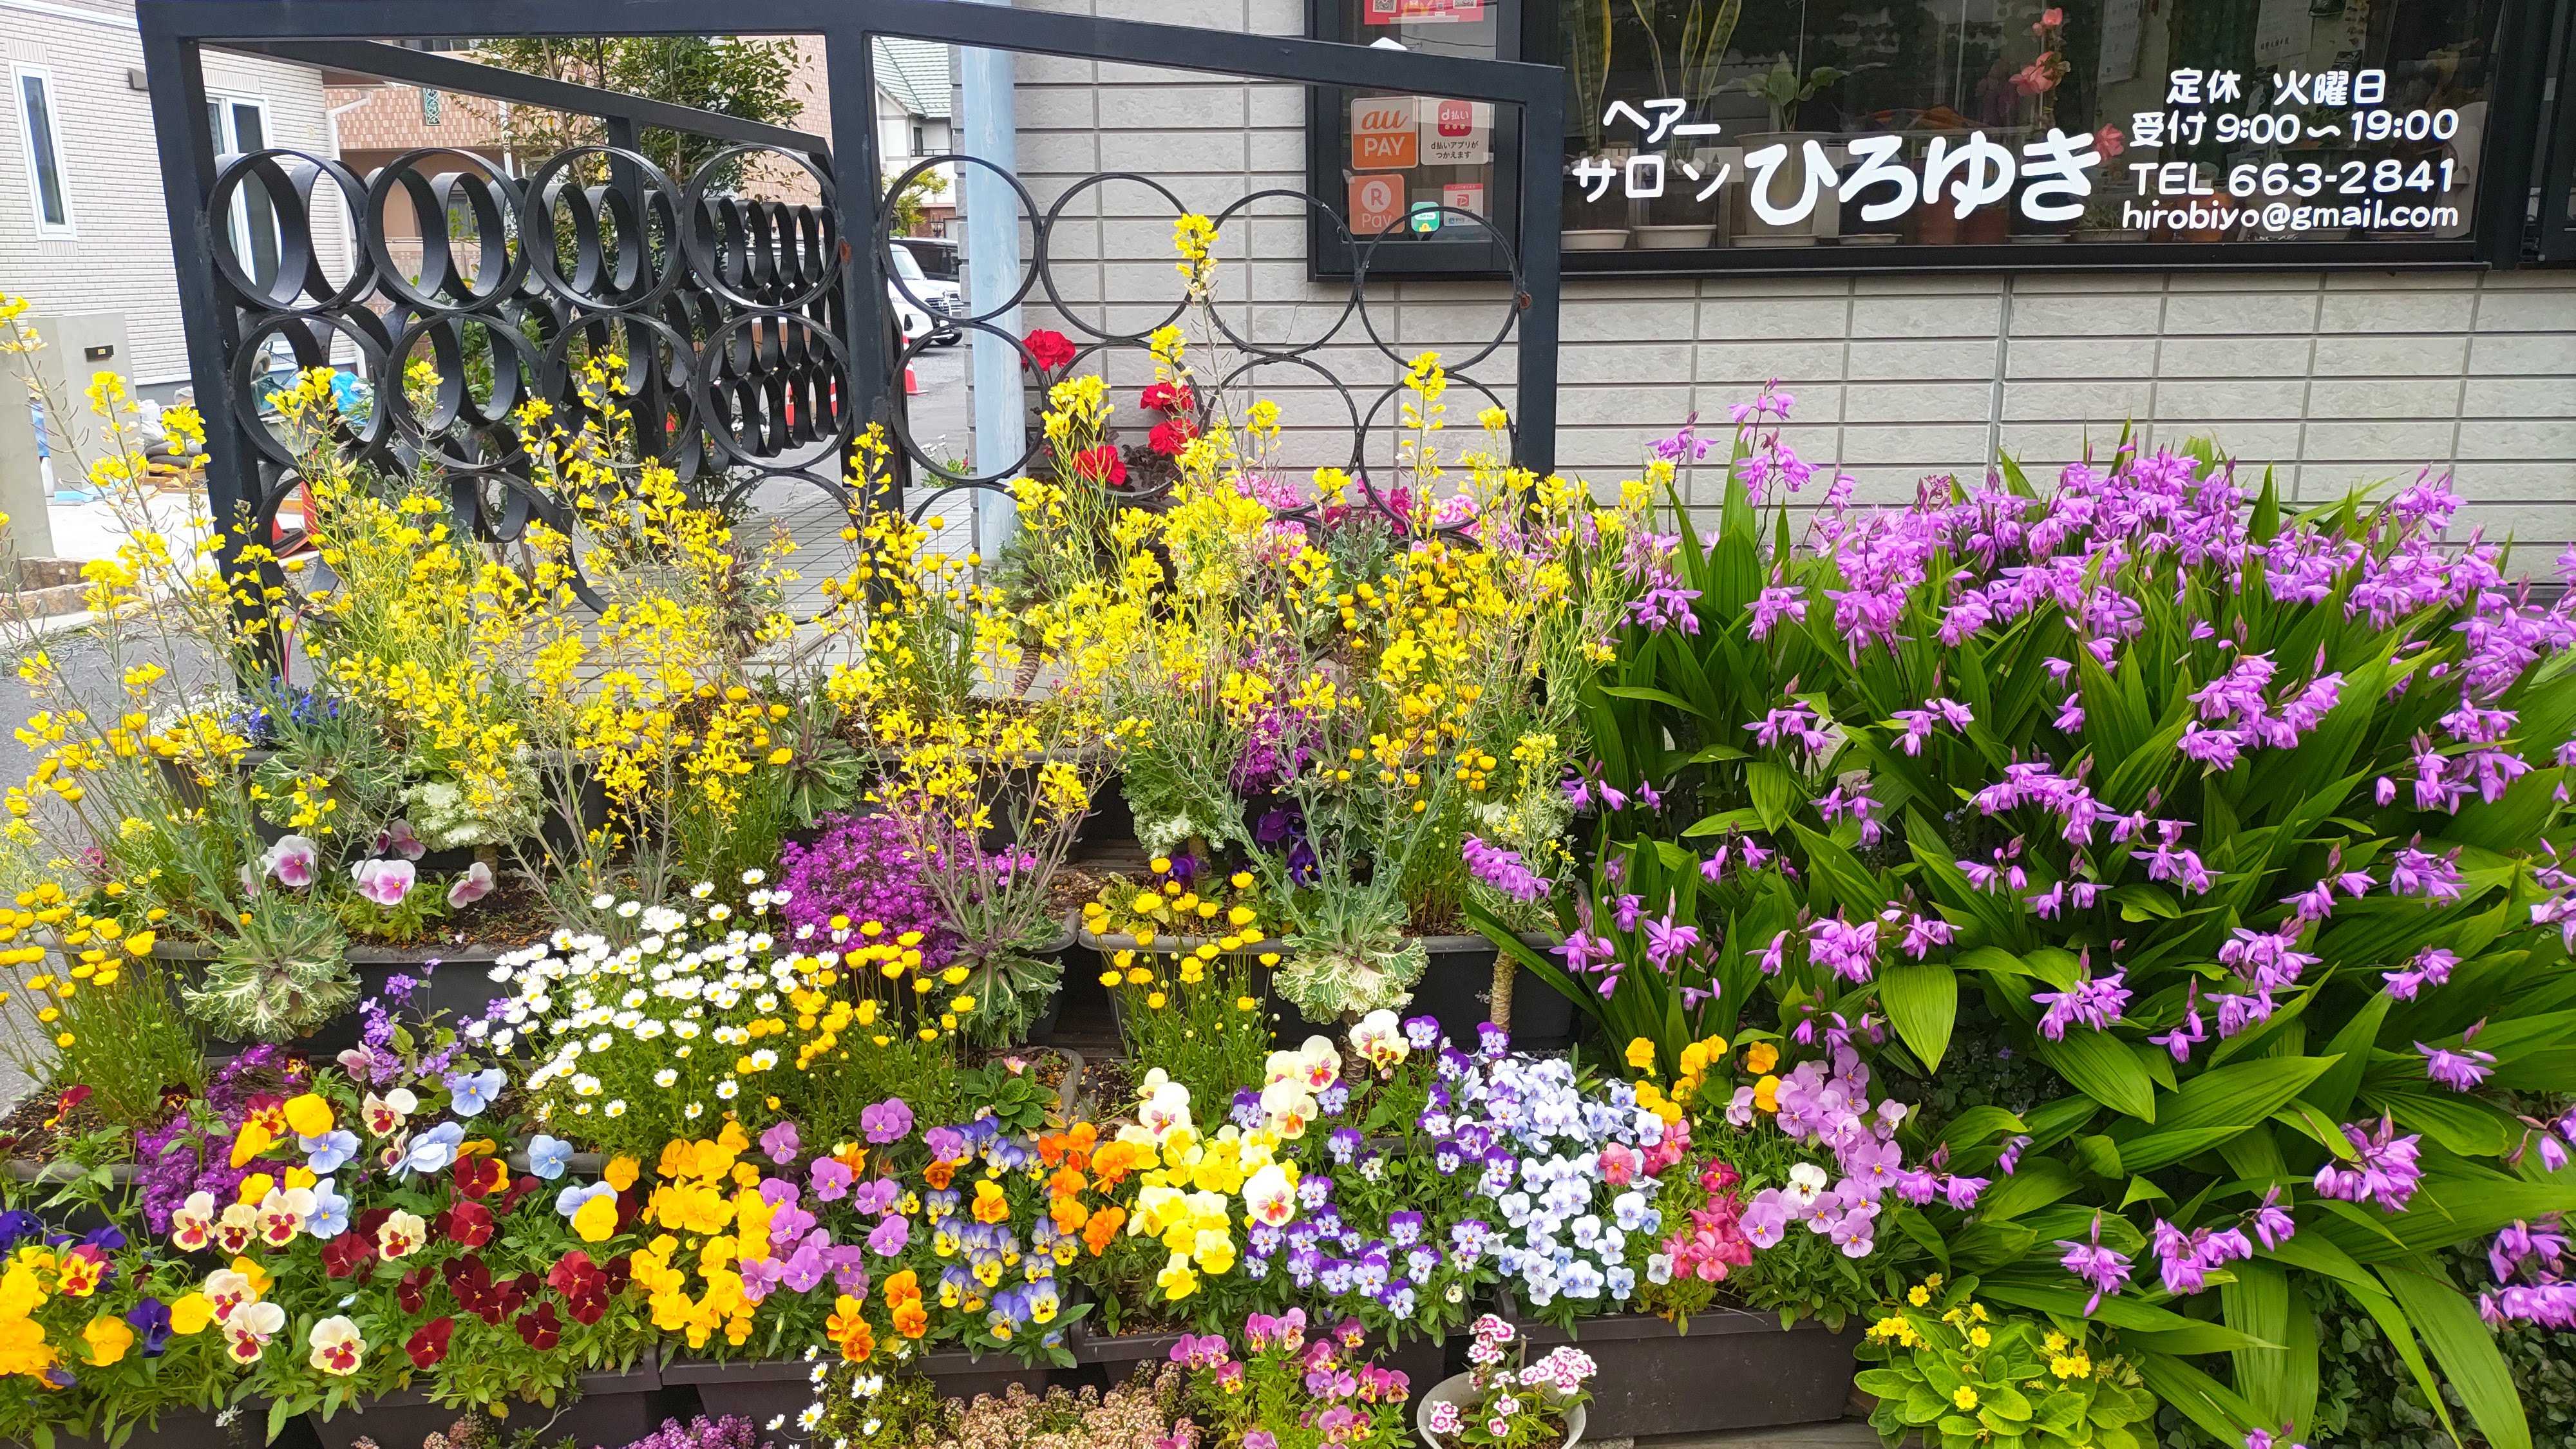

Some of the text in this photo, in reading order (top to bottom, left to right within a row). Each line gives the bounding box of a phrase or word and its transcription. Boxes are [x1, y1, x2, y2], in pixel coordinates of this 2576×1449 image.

[2166, 67, 2387, 106] 定休 火曜日
[1361, 110, 1408, 130] au
[1441, 108, 1469, 121] d払い
[1602, 97, 1721, 144] ヘアー
[2128, 109, 2207, 147] 受付
[1364, 136, 1405, 156] PAY
[1430, 140, 1479, 149] d払いアプリが
[1436, 151, 1472, 159] つかえます
[1571, 155, 1731, 203] サロン
[1743, 127, 2102, 226] ひろゆき
[2128, 157, 2454, 197] TEL 663-2841
[1370, 188, 1383, 206] R
[2122, 198, 2459, 232] hirobiyo@gmail.com
